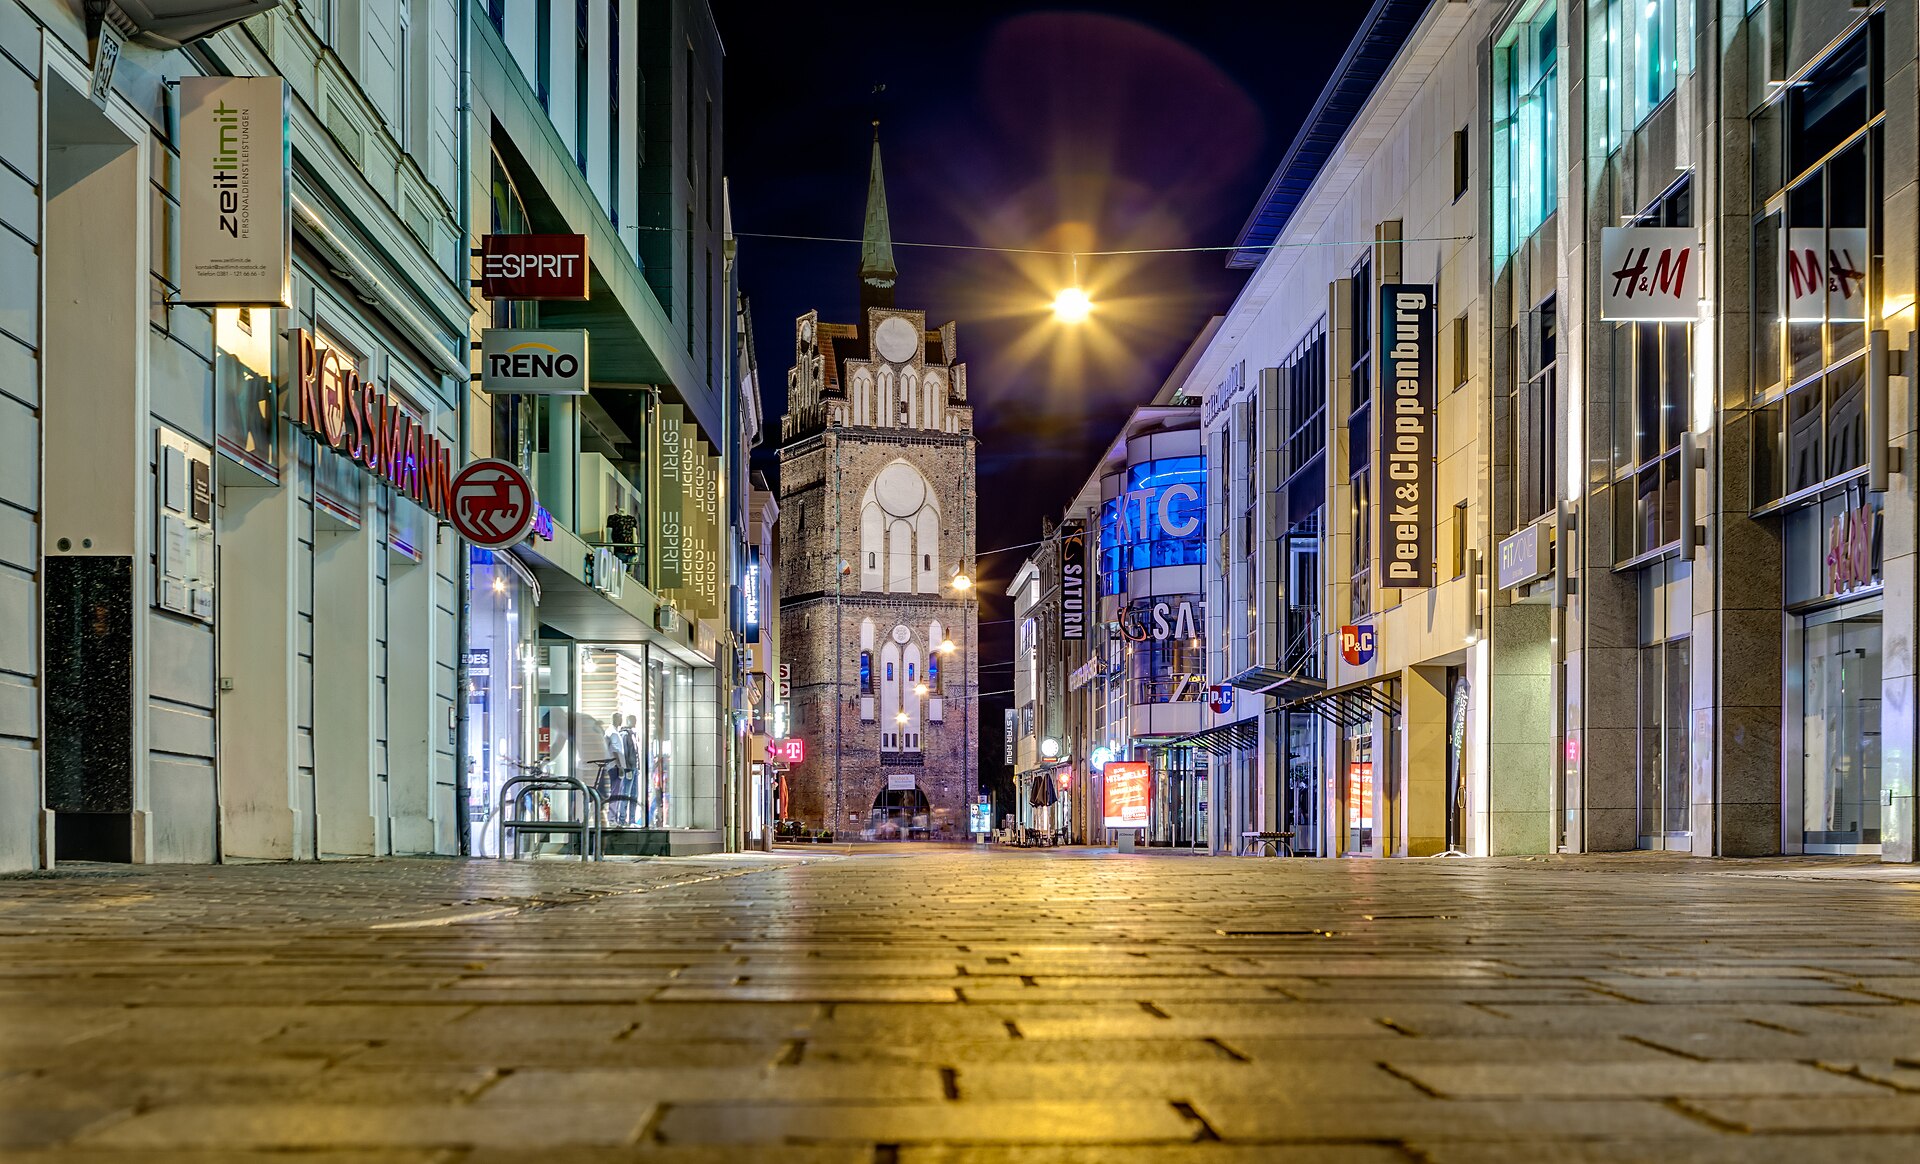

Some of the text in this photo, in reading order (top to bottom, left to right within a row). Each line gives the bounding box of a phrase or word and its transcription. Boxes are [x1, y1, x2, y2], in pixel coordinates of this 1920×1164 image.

[213, 98, 238, 239] zeitlimit
[242, 108, 250, 239] PERSONALDIENSTLEISTUNGEN
[486, 254, 580, 279] ESPRIT
[1612, 247, 1690, 299] H&M
[489, 353, 579, 379] RENO
[298, 327, 451, 520] ROSSMANN
[663, 419, 679, 482] ESPRIT
[663, 511, 679, 574] ESPRIT
[1116, 483, 1199, 545] KTC
[1064, 564, 1083, 638] SATURN
[1344, 632, 1373, 652] P&C
[1210, 690, 1231, 705] P&C
